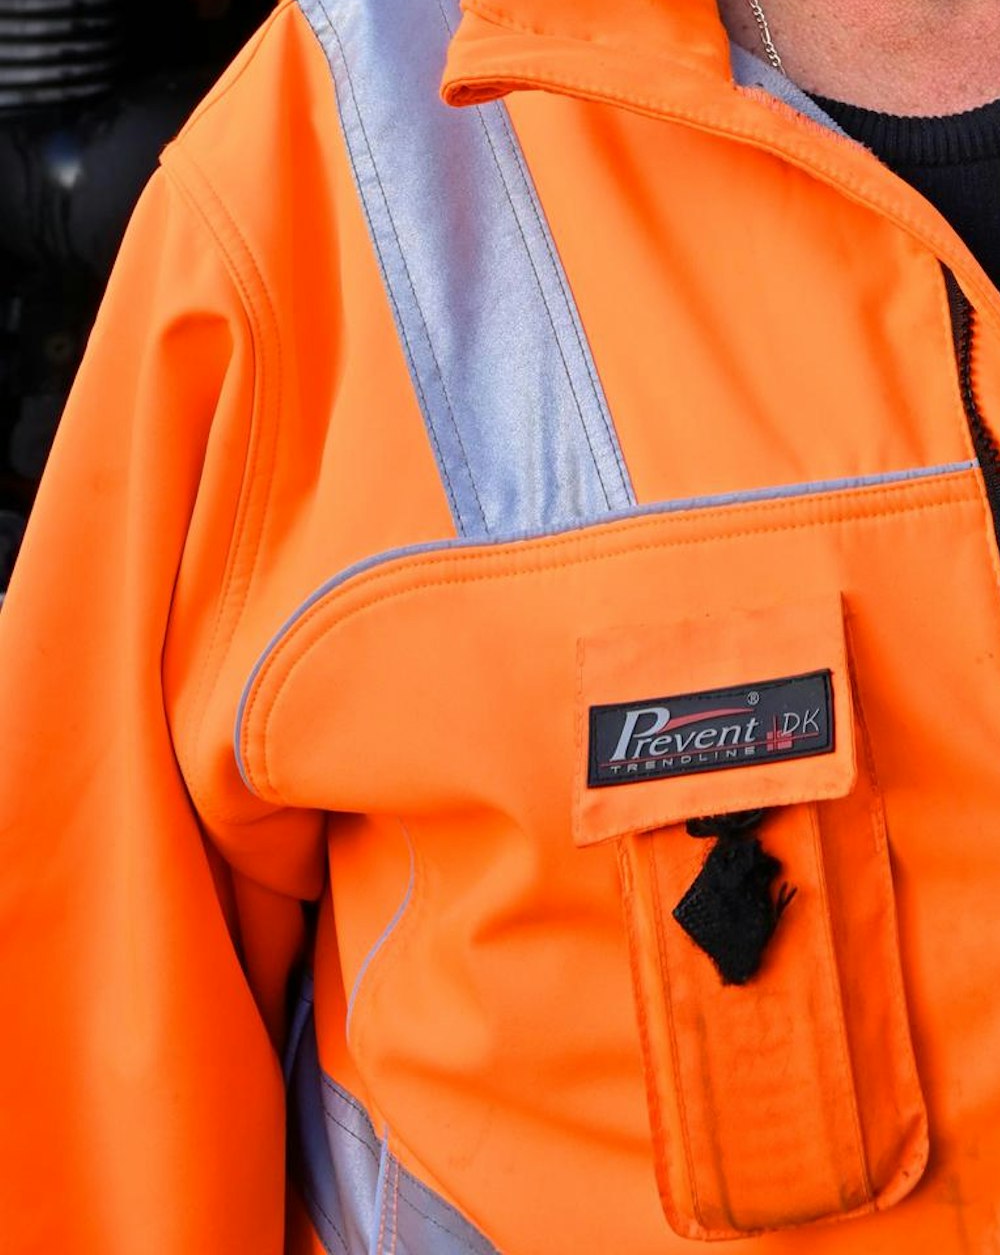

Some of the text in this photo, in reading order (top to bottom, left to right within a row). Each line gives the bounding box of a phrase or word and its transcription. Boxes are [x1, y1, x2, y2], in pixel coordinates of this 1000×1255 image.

[609, 707, 820, 761] Prevent DK
[610, 746, 756, 774] TRENDLINE
